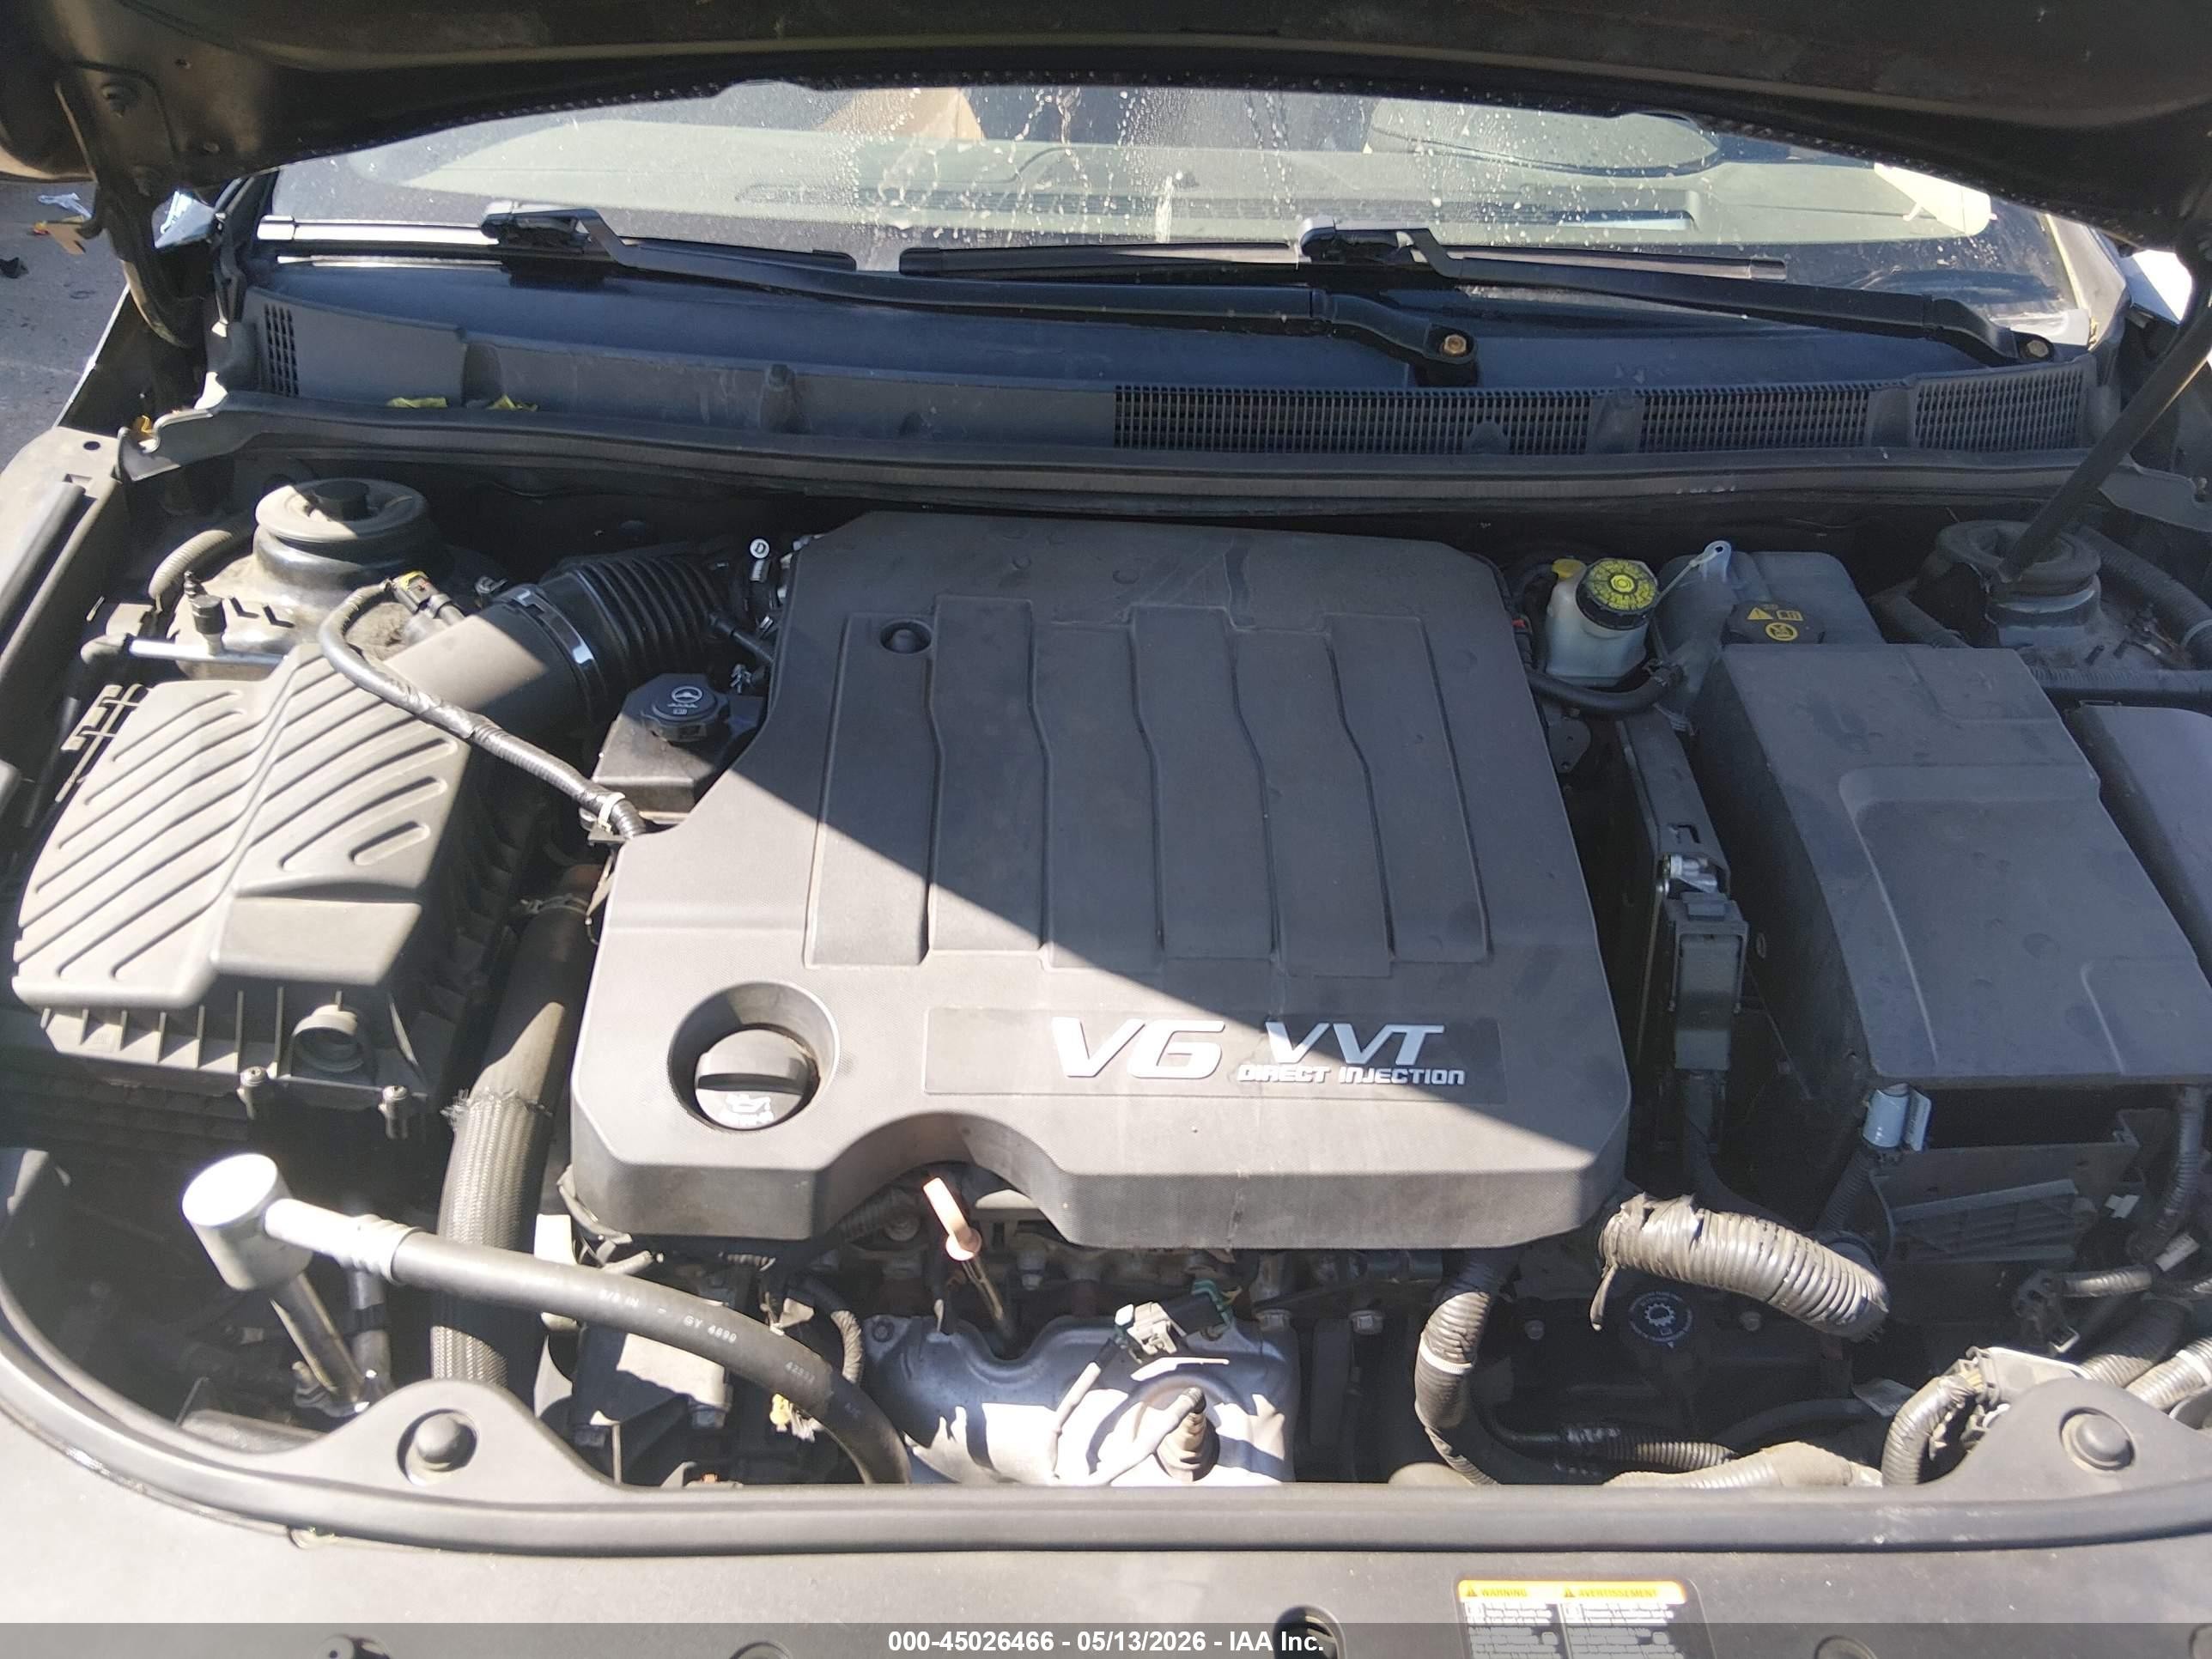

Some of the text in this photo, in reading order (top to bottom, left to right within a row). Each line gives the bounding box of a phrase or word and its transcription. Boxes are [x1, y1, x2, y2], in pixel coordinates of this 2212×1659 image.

[1051, 1017, 1445, 1079] V6 VVT
[1237, 1065, 1465, 1085] DIRECT INJECTION
[1481, 1588, 1528, 1597] WARNING
[1578, 1588, 1658, 1597] AVERTISSEMENT
